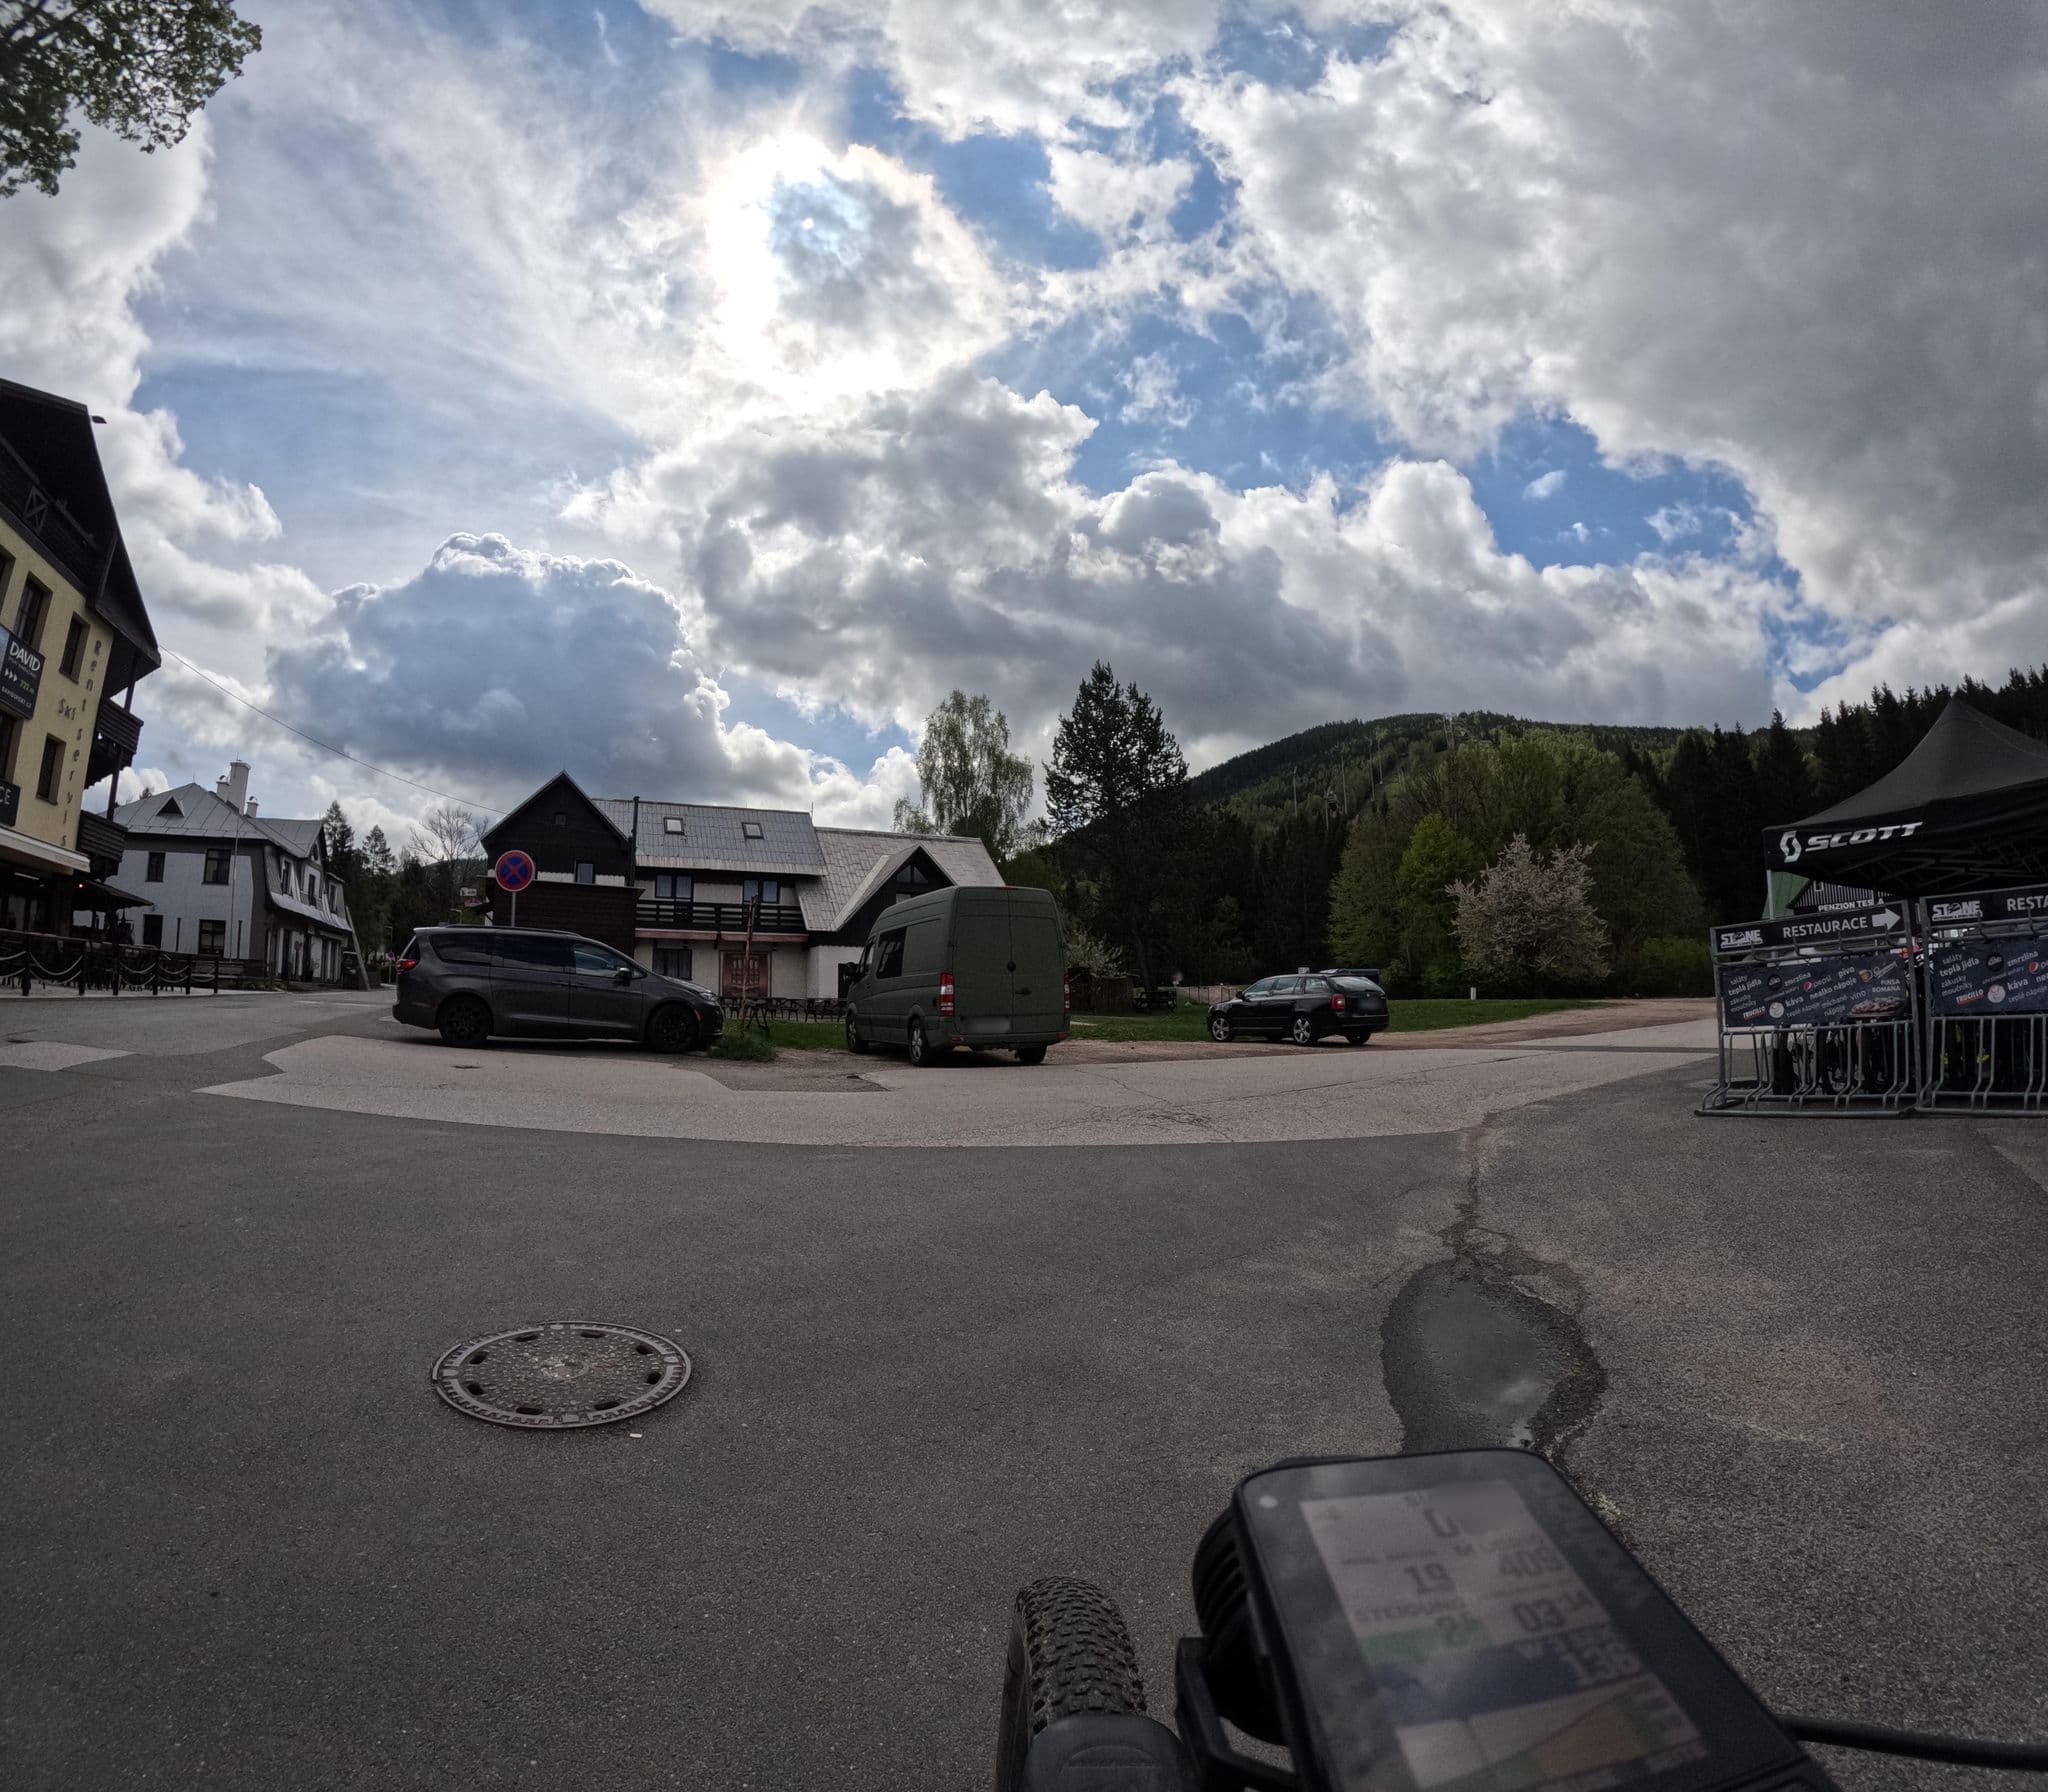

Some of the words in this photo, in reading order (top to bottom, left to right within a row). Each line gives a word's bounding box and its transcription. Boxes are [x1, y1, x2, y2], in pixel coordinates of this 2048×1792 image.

[9, 641, 41, 671] DAVID
[1804, 821, 1923, 852] SCOTT
[1818, 901, 1855, 912] PENZION
[1782, 916, 1869, 939] RESTAURACE
[1838, 966, 1855, 979] pivo
[2007, 979, 2029, 991] káva
